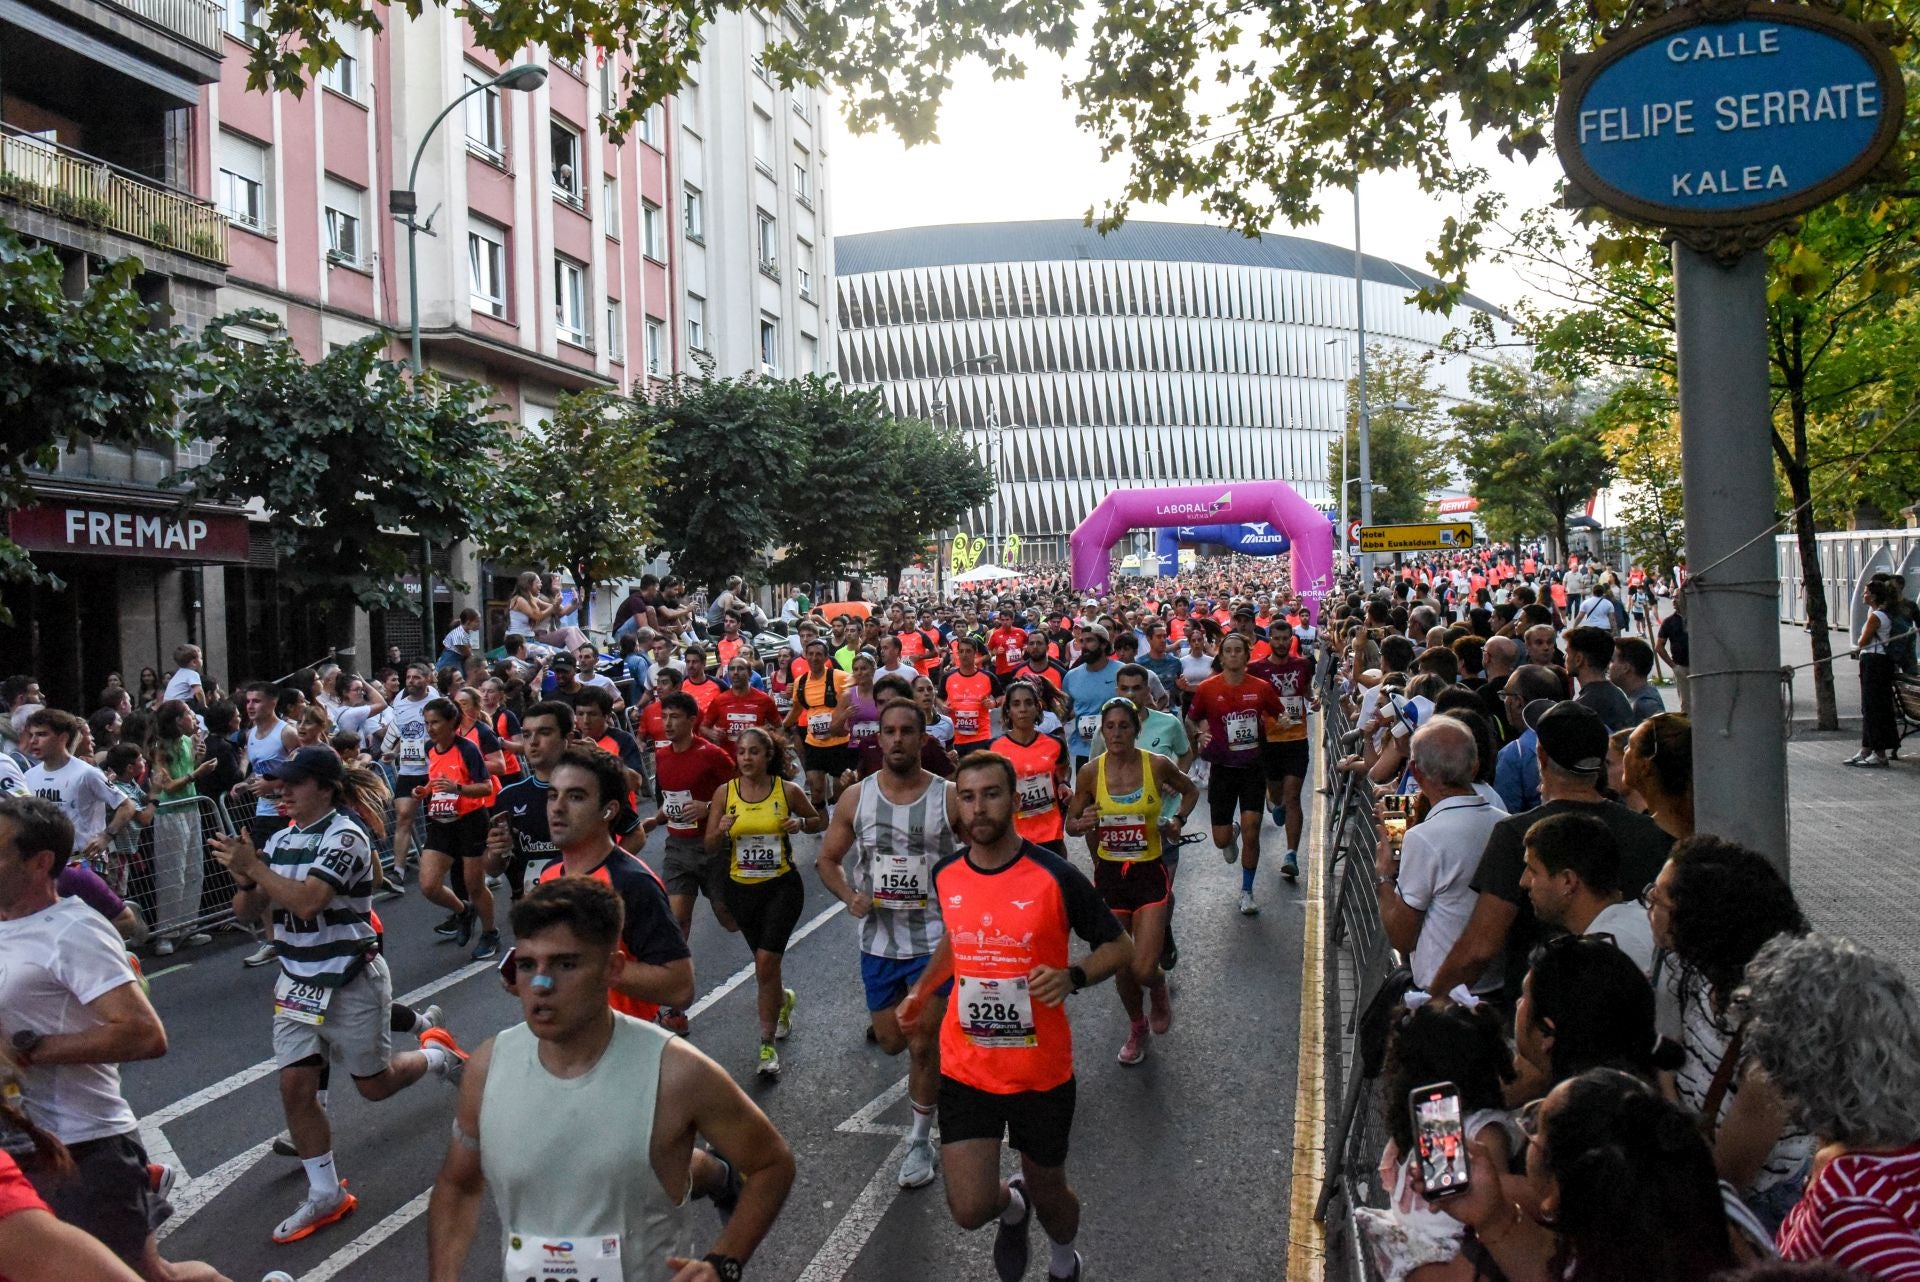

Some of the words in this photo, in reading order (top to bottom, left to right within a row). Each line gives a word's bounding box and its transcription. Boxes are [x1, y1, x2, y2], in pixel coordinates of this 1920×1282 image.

[1667, 28, 1780, 62] CALLE
[1579, 100, 1695, 145] FELIPE
[1715, 81, 1879, 132] SERRATE
[1672, 165, 1788, 197] KALEA
[1156, 503, 1208, 515] LABORAL
[65, 509, 208, 551] FREMAP
[1362, 530, 1386, 539] Hotel
[1241, 534, 1282, 544] MIZUNO
[1363, 541, 1385, 549] Abba
[1388, 538, 1437, 548] Euskalduna
[953, 557, 959, 569] 3
[1235, 728, 1252, 738] 522
[1020, 786, 1048, 802] 2411
[430, 803, 455, 812] 21146
[1102, 829, 1144, 842] 28376
[742, 848, 774, 860] 3128
[881, 873, 919, 888] 1546
[287, 980, 325, 1000] 2620
[968, 1002, 1020, 1020] 3286
